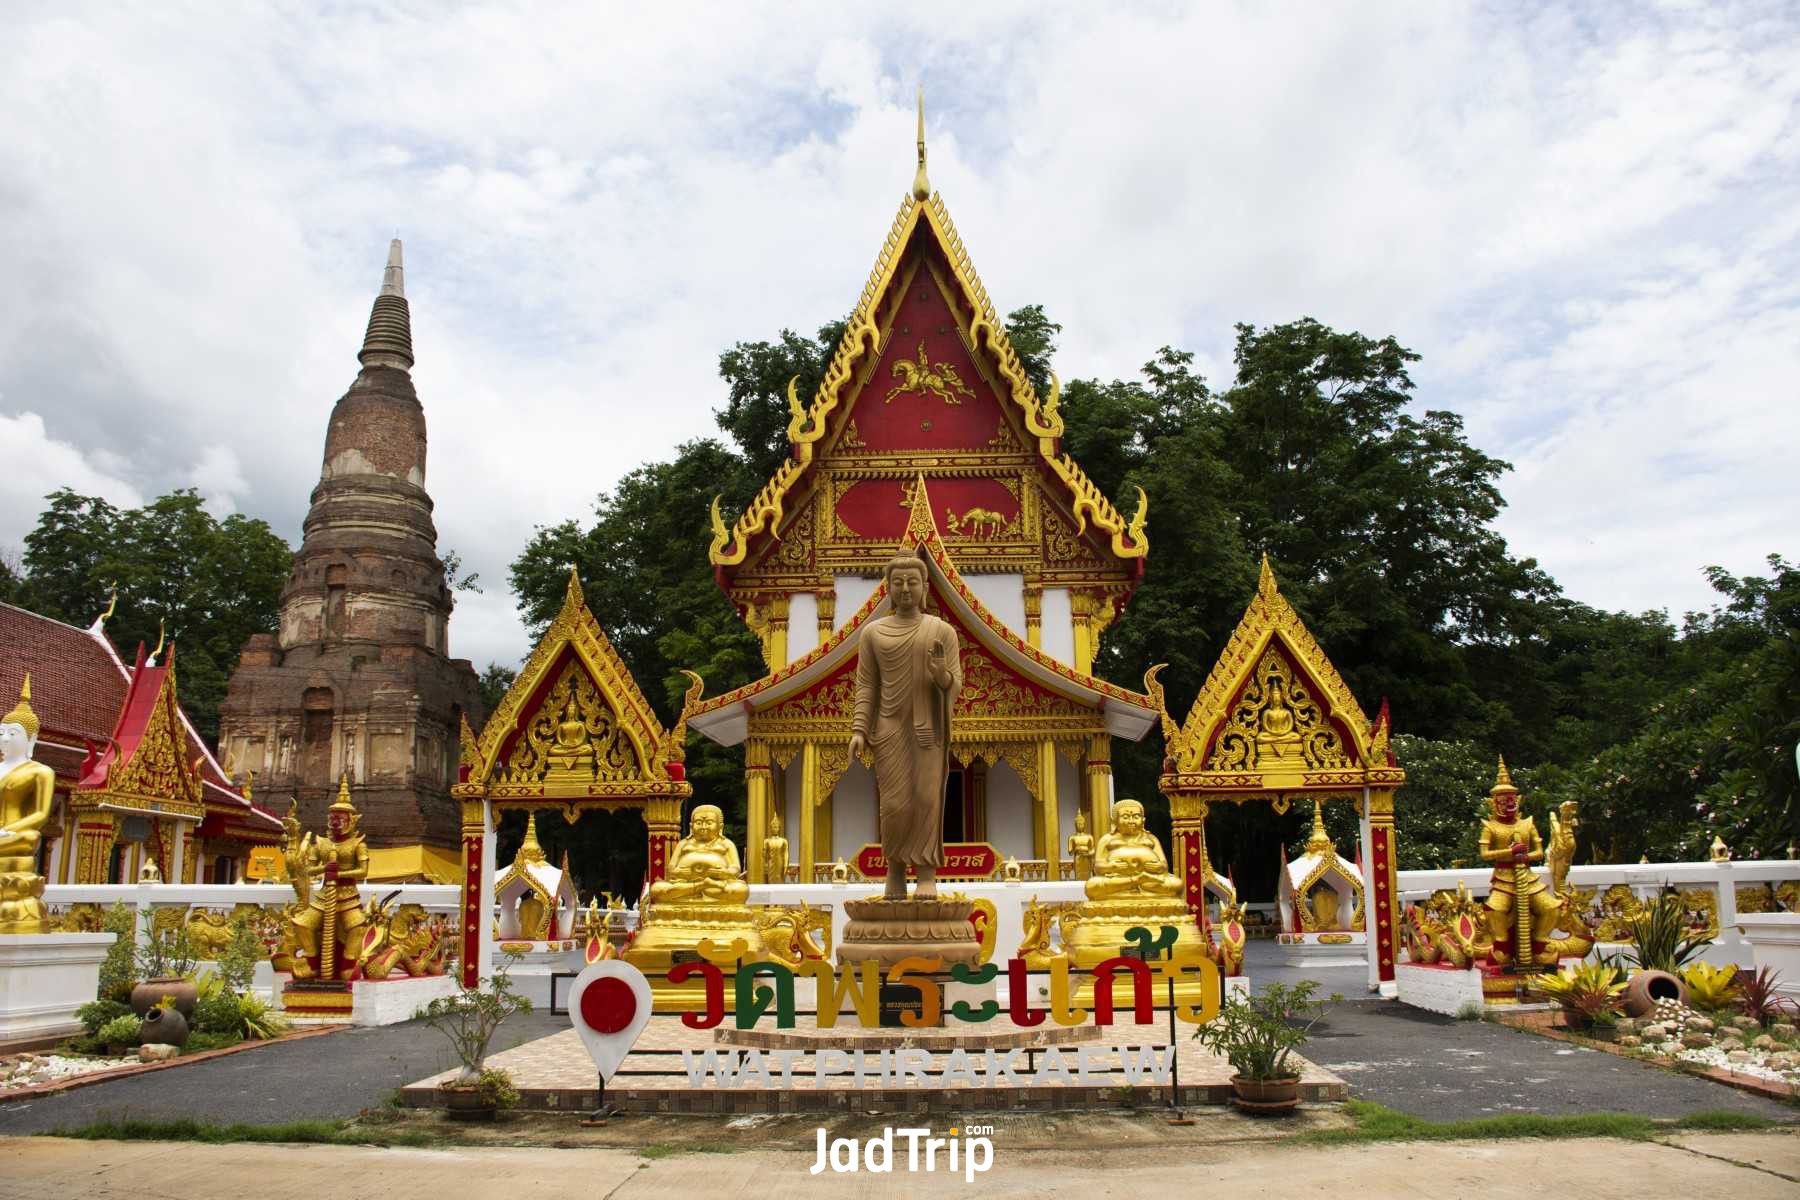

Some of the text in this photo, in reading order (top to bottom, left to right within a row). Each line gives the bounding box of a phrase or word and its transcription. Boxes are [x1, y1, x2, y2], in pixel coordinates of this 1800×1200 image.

[667, 925, 1219, 1030] วัดพระแก้ว
[681, 1049, 804, 1088] WAT
